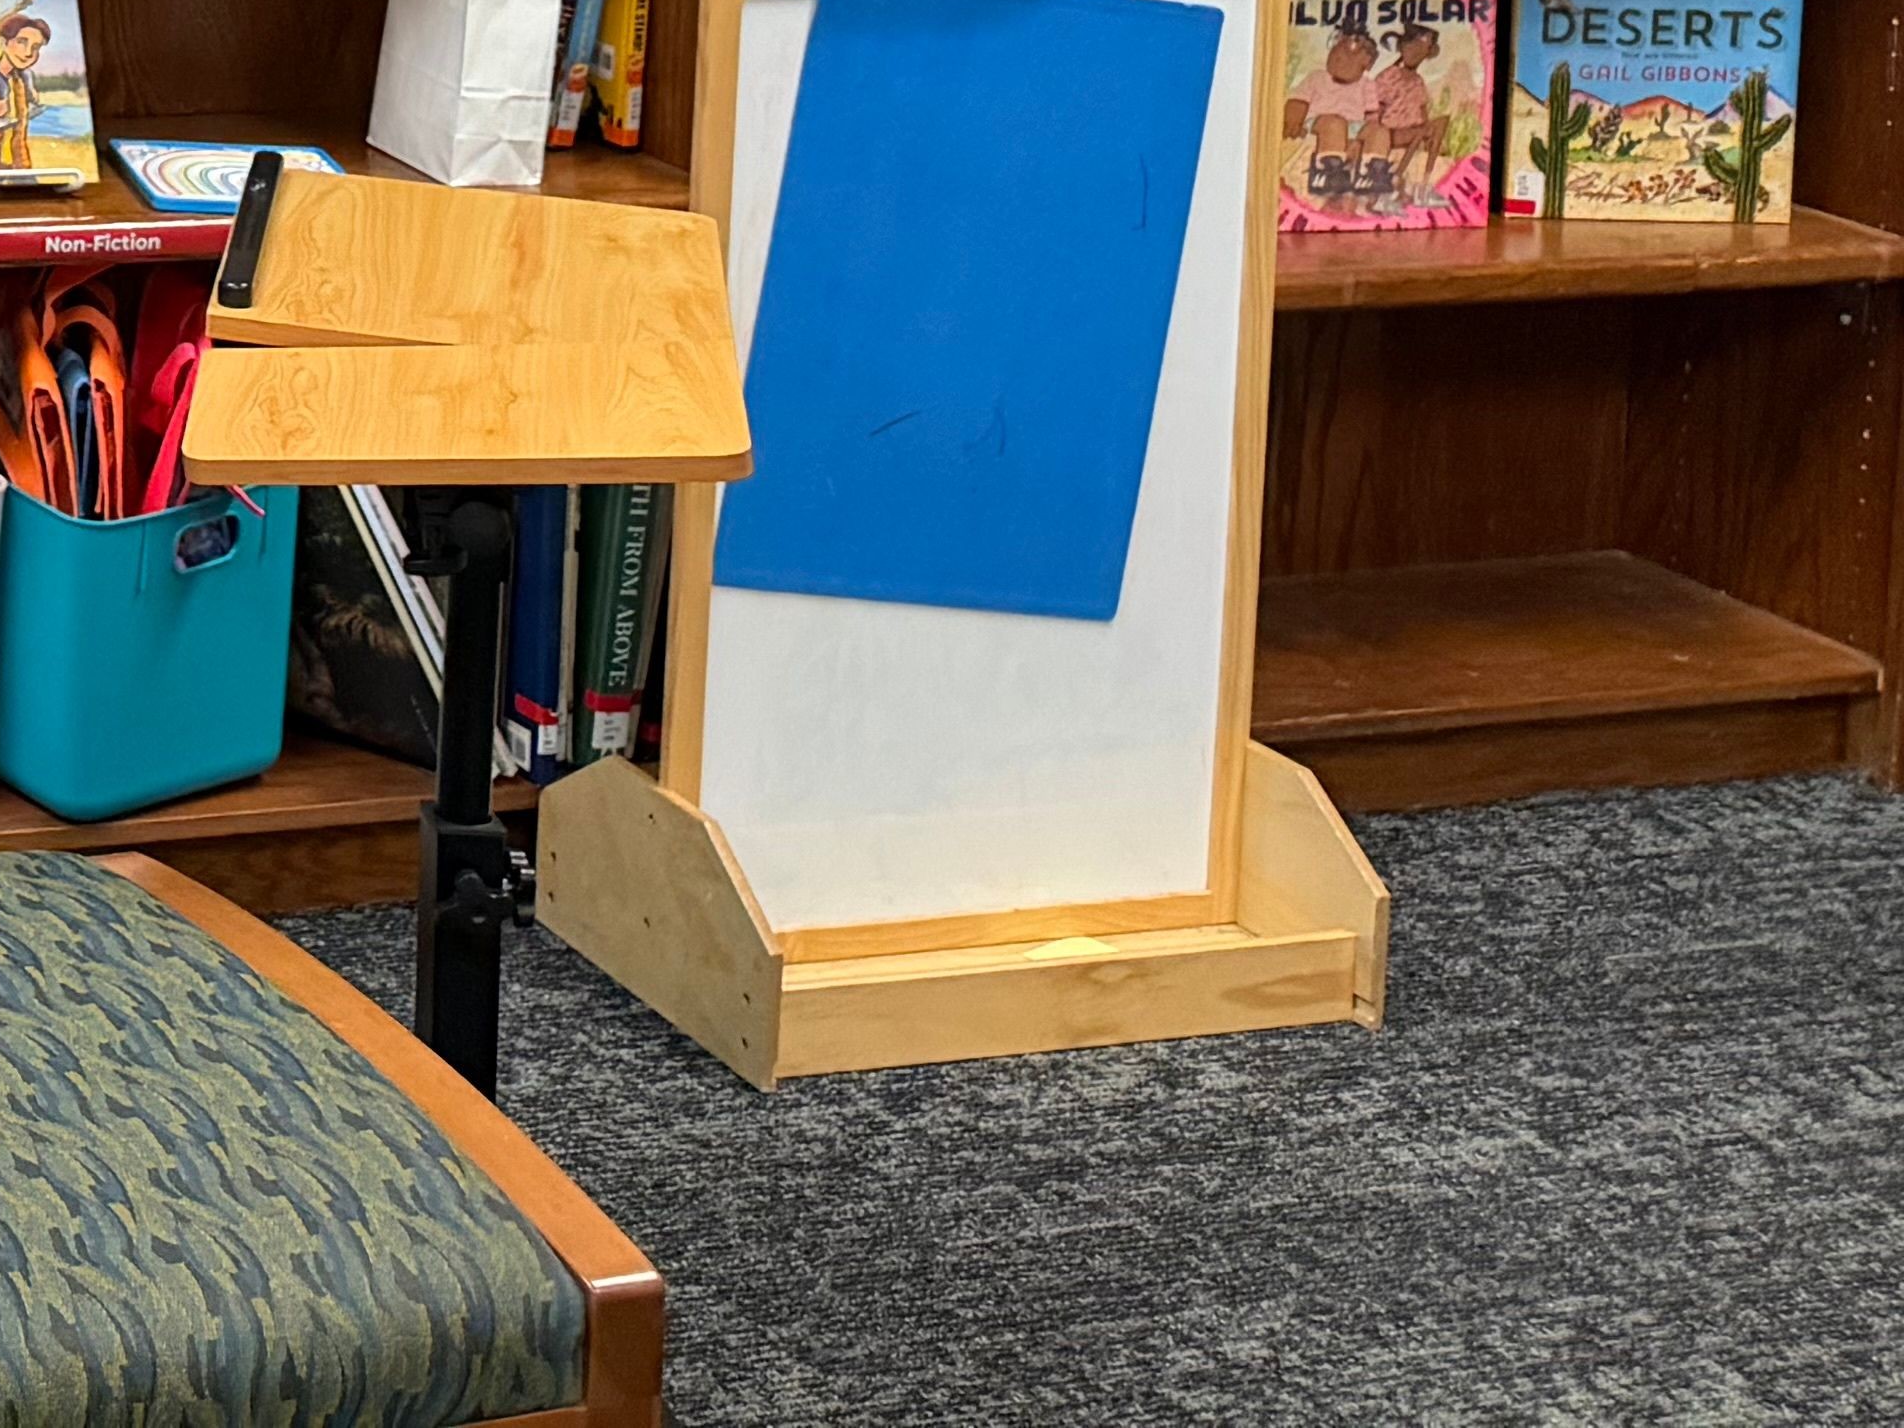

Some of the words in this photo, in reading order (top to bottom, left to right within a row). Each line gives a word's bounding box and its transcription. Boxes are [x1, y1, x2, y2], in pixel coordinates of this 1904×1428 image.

[1541, 5, 1786, 49] DESERTS
[1578, 64, 1631, 82] GAIL
[1642, 64, 1741, 84] GIBBONS
[45, 234, 161, 253] Non-Fiction
[618, 530, 648, 597] FROM
[608, 603, 636, 688] ABOVE
